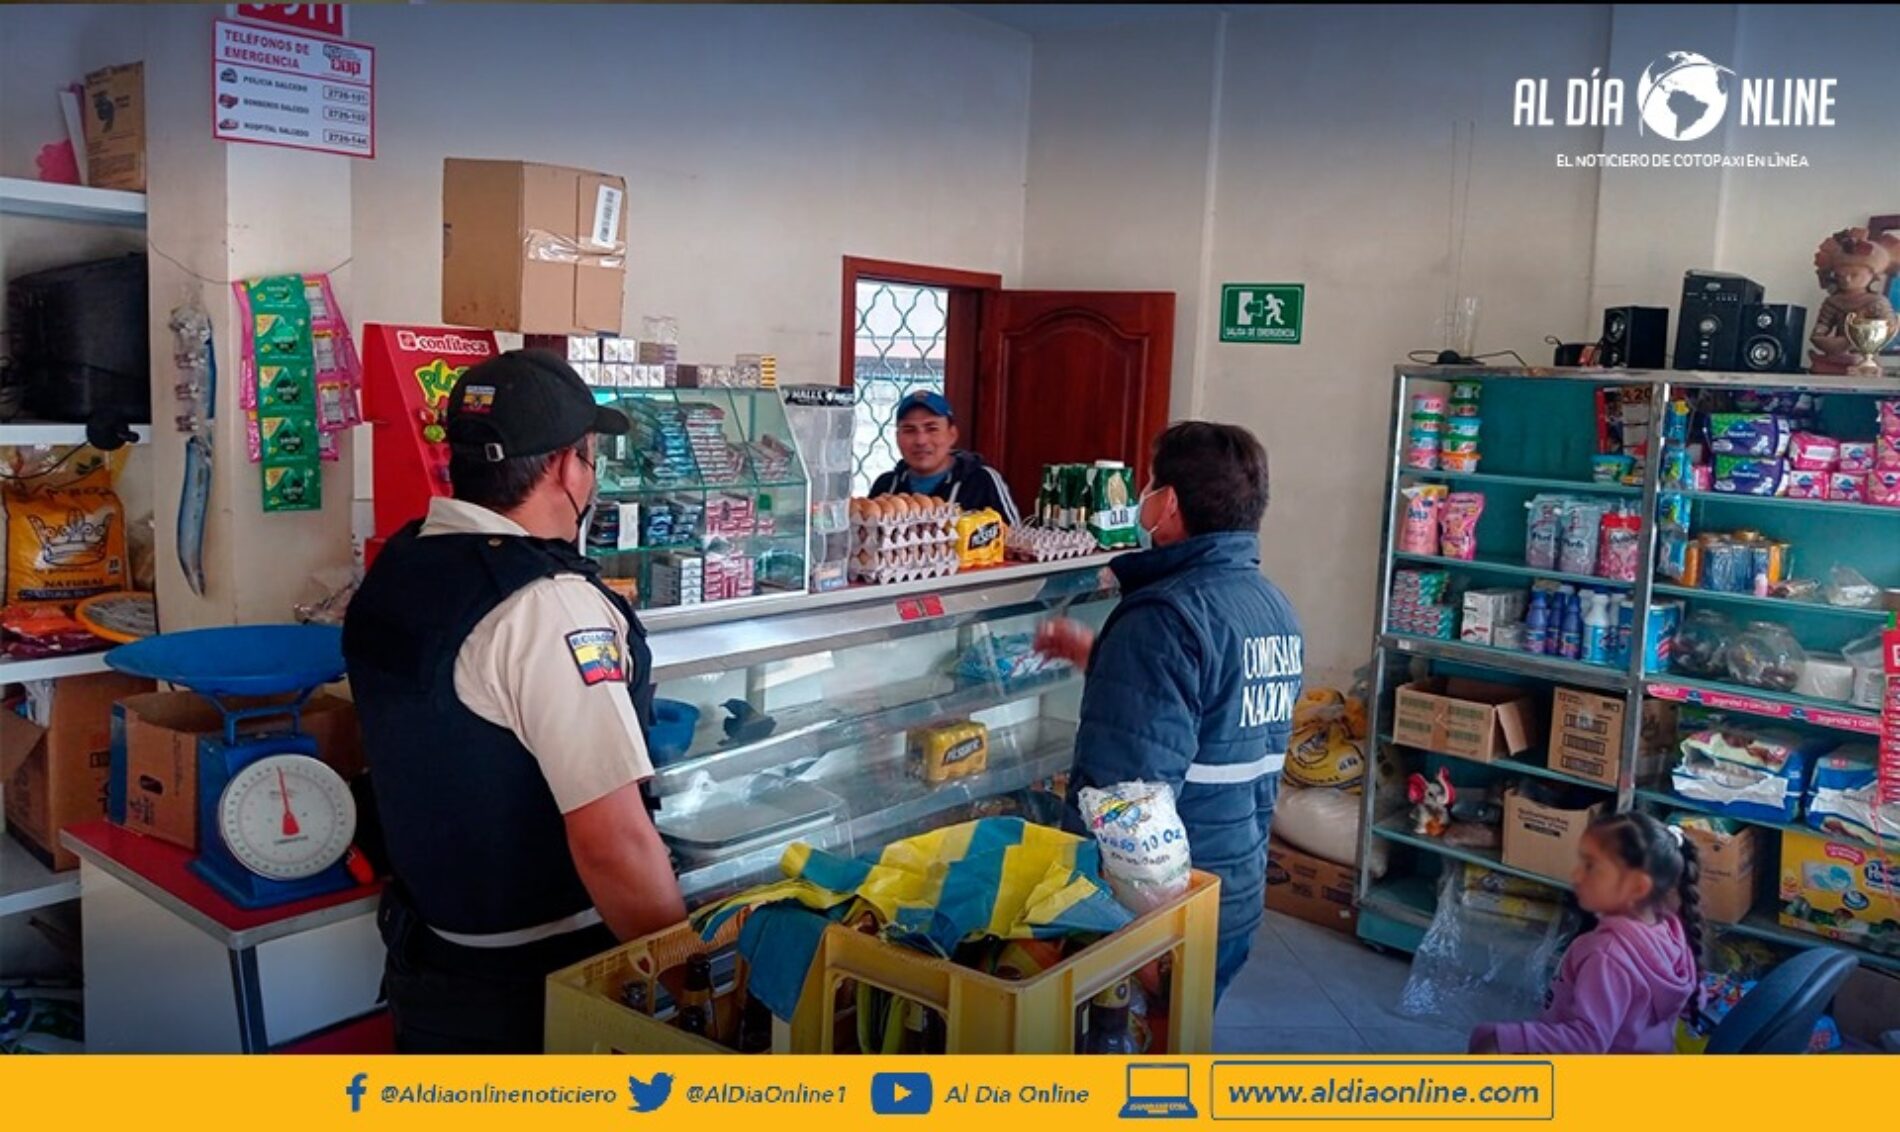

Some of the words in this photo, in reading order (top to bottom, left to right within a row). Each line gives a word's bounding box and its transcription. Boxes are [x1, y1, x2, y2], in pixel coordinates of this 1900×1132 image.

[224, 46, 300, 69] EMERGENCIA
[295, 42, 310, 56] DE
[243, 122, 278, 134] HOSPITAL
[419, 337, 489, 354] confiteca
[1141, 833, 1160, 853] 10
